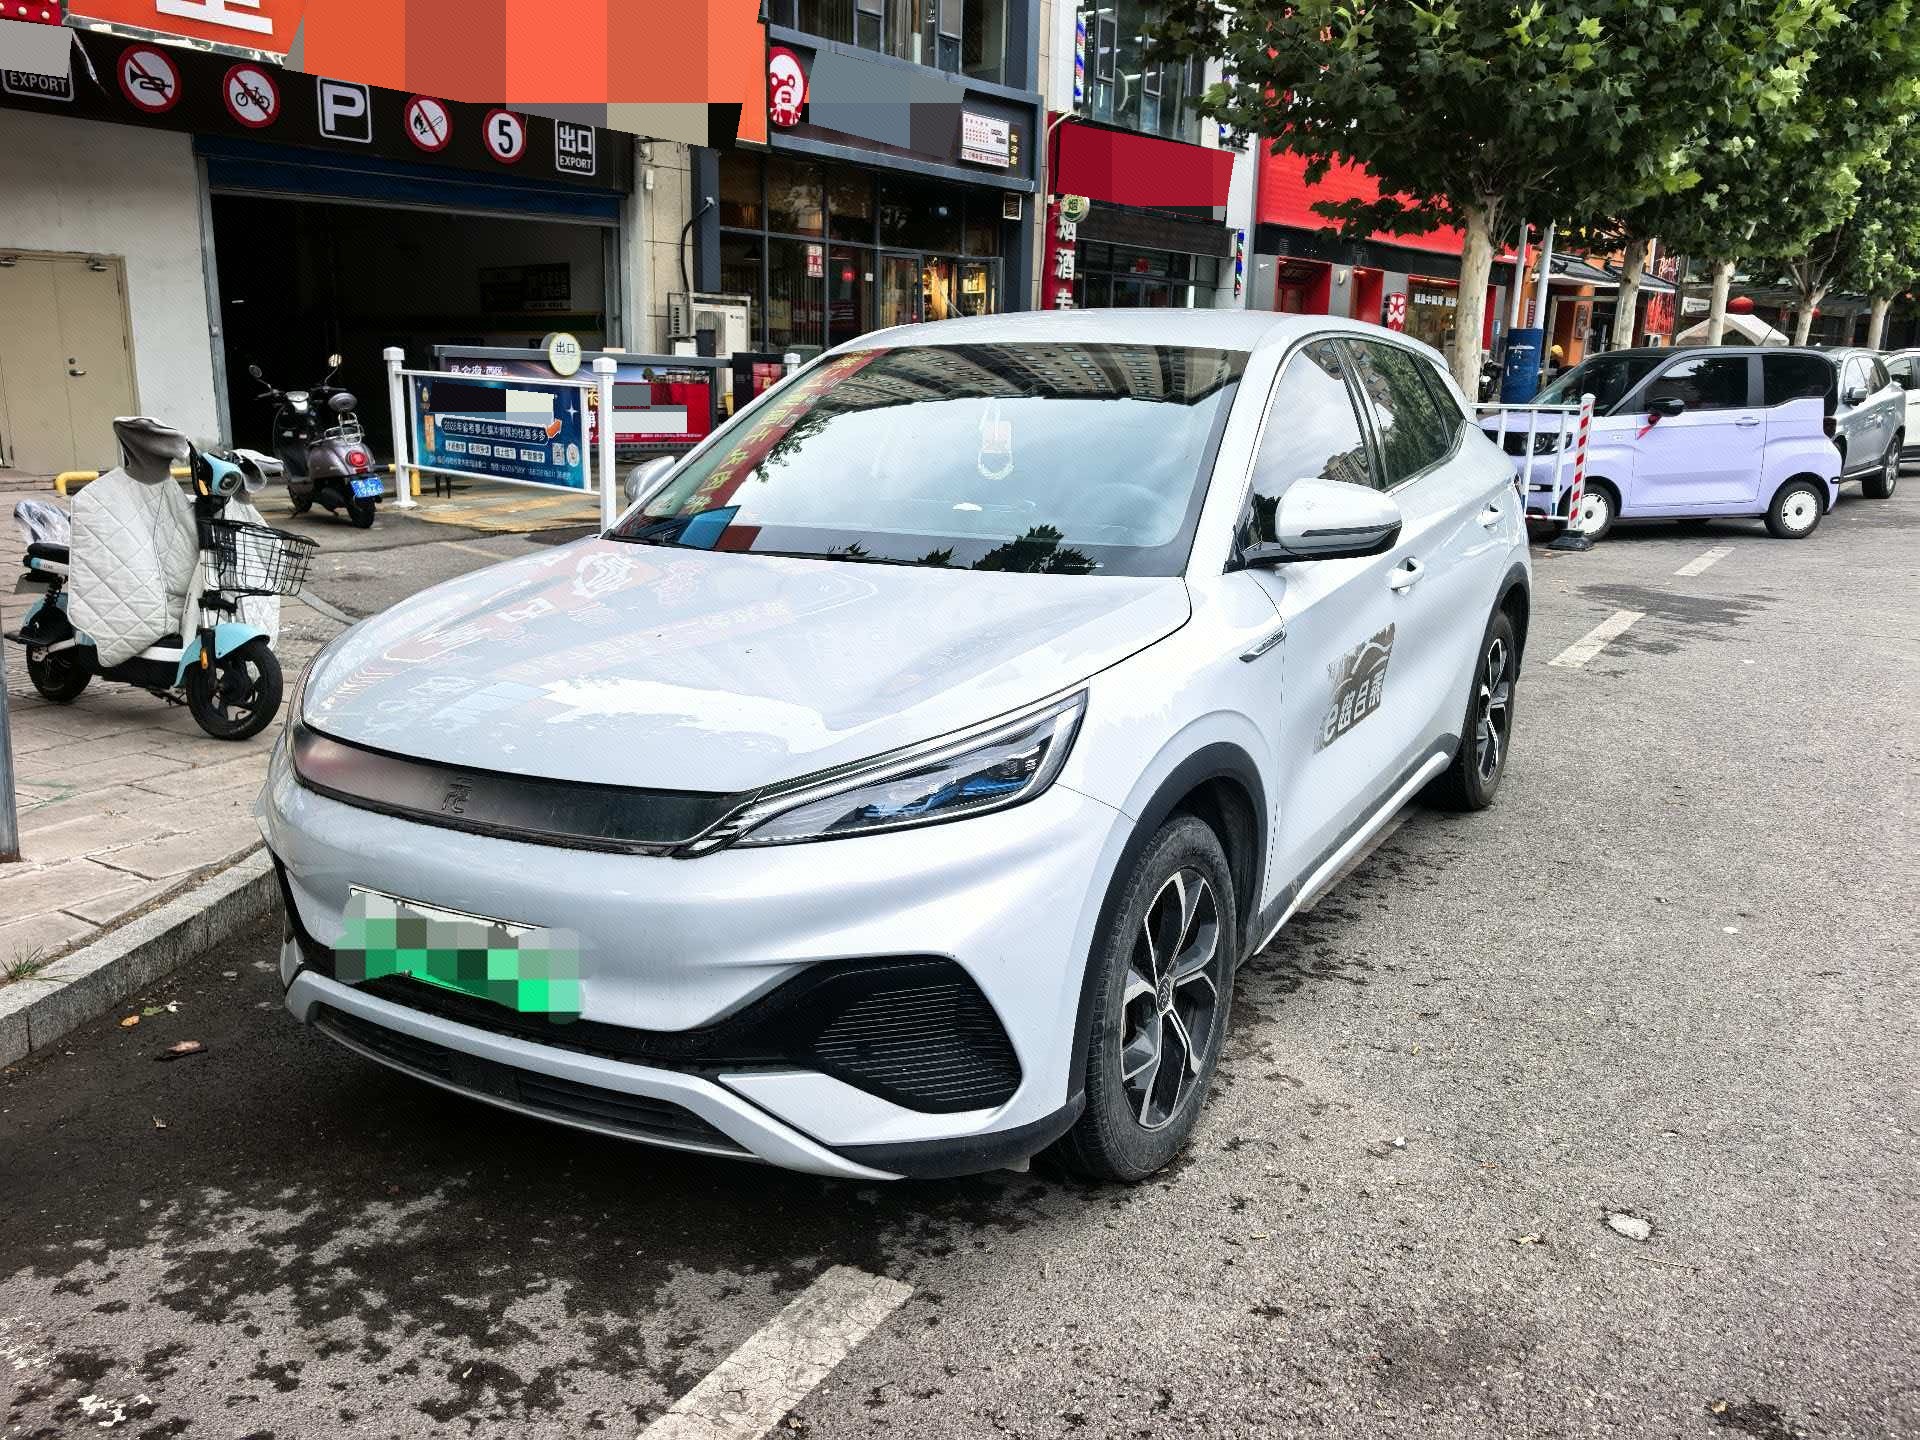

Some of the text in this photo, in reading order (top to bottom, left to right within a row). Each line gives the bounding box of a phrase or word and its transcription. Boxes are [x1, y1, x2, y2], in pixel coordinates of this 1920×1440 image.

[9, 71, 67, 93] EXPORT
[322, 84, 366, 131] P
[498, 119, 514, 154] 5
[559, 124, 593, 155] 出口
[559, 155, 593, 169] EXPORT
[556, 341, 576, 354] 出口
